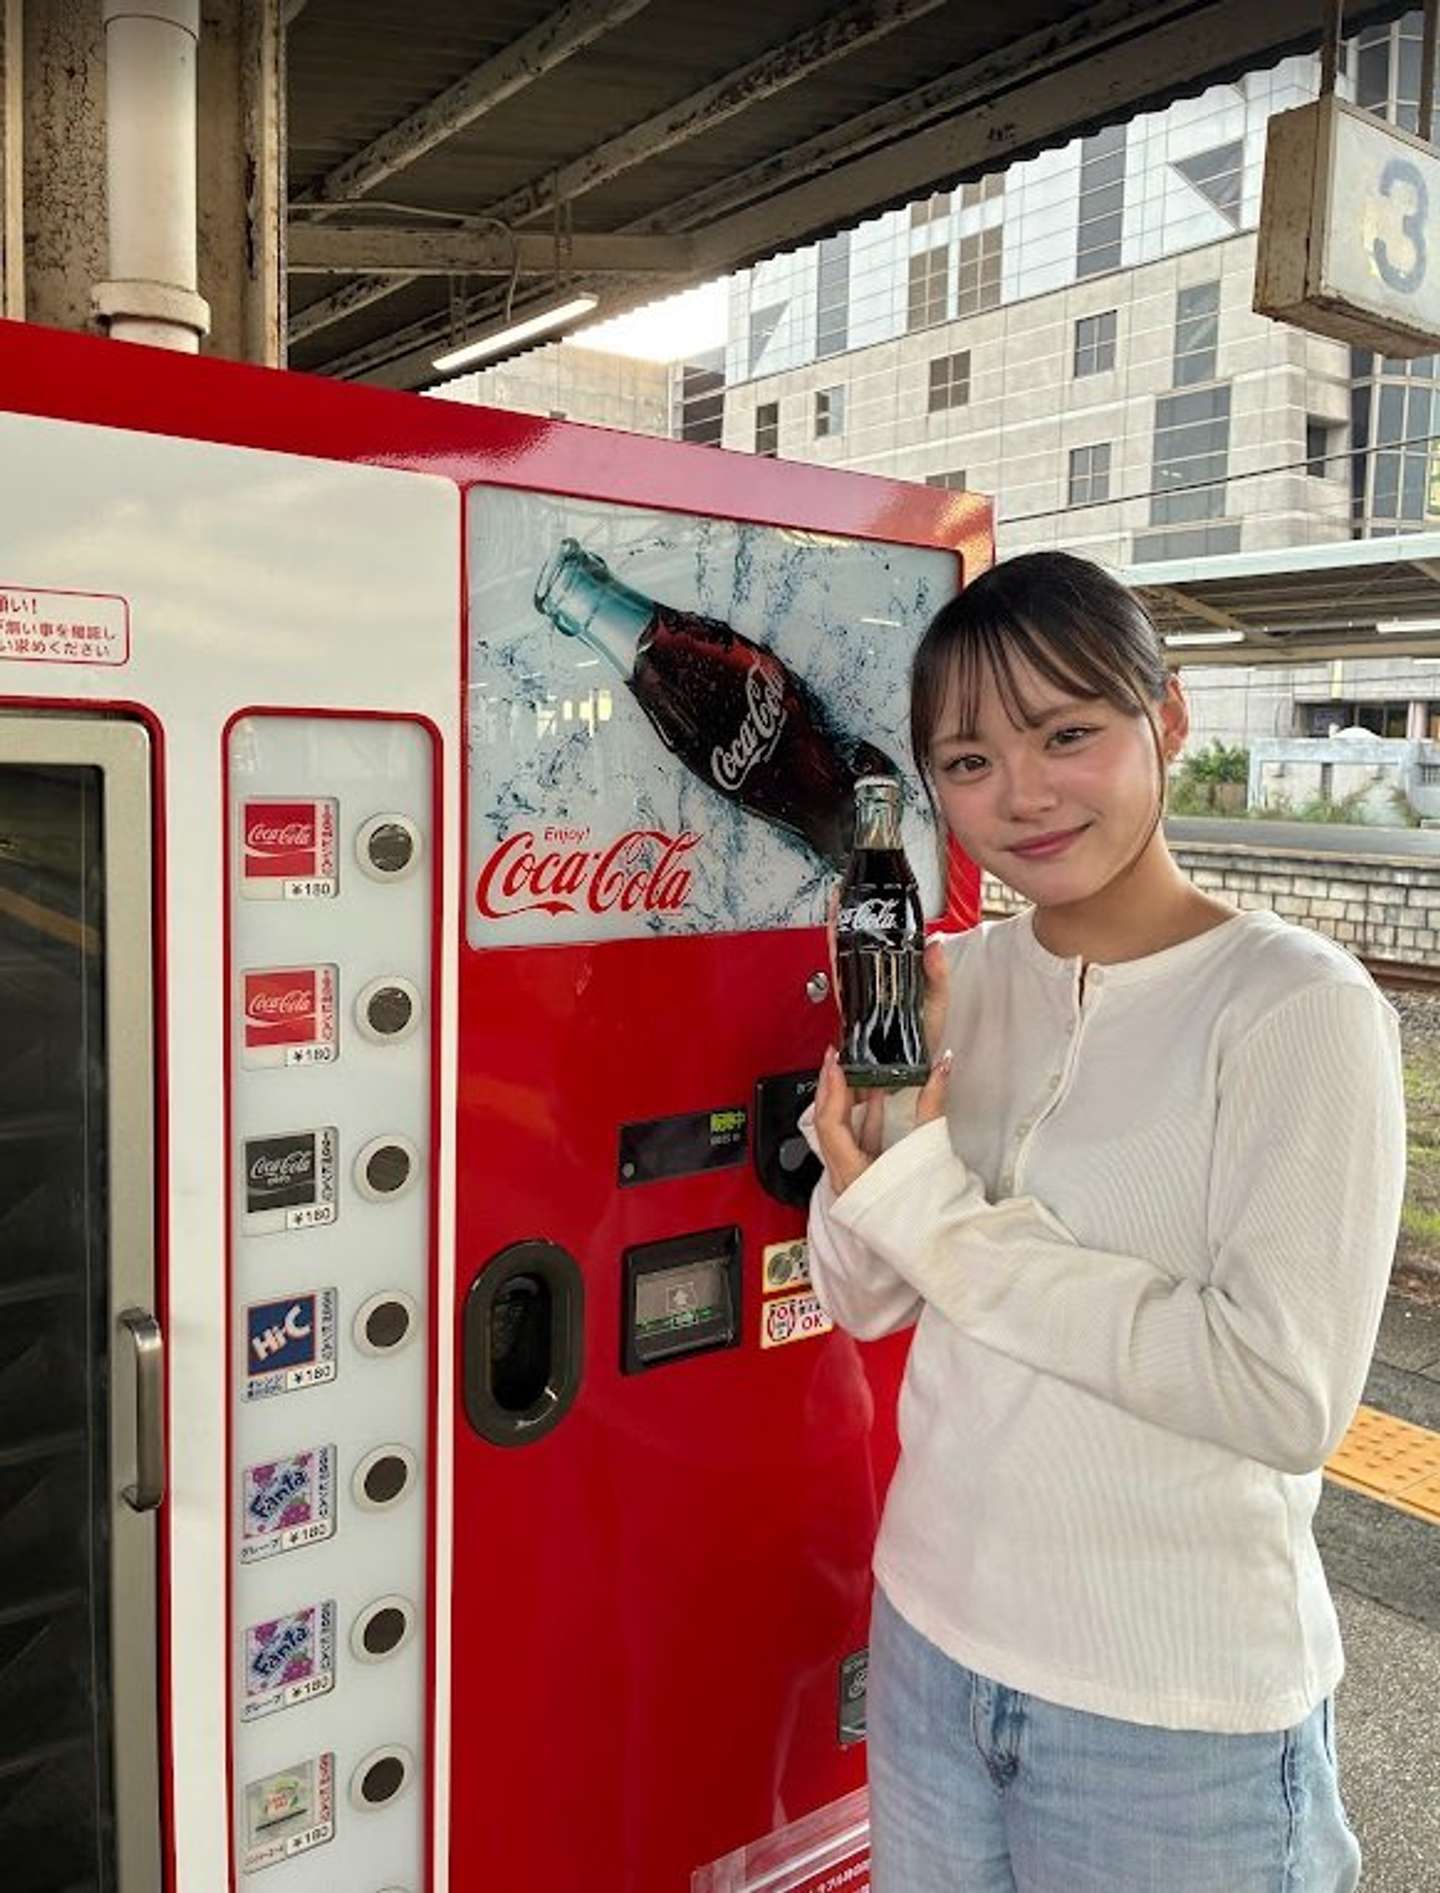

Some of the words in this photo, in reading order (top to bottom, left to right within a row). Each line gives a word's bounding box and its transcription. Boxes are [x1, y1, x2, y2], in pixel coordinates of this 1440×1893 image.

[1373, 157, 1429, 295] 3
[544, 825, 591, 845] Enjoy!
[292, 882, 331, 897] ¥180
[293, 1046, 331, 1062] ¥180
[294, 1206, 331, 1223] ¥180
[294, 1365, 331, 1384] ¥180
[250, 1470, 309, 1518] Fanta
[289, 1523, 326, 1543] ¥180
[252, 1626, 309, 1676] Fanta
[291, 1675, 329, 1698] ¥180
[292, 1825, 329, 1848] ¥180
